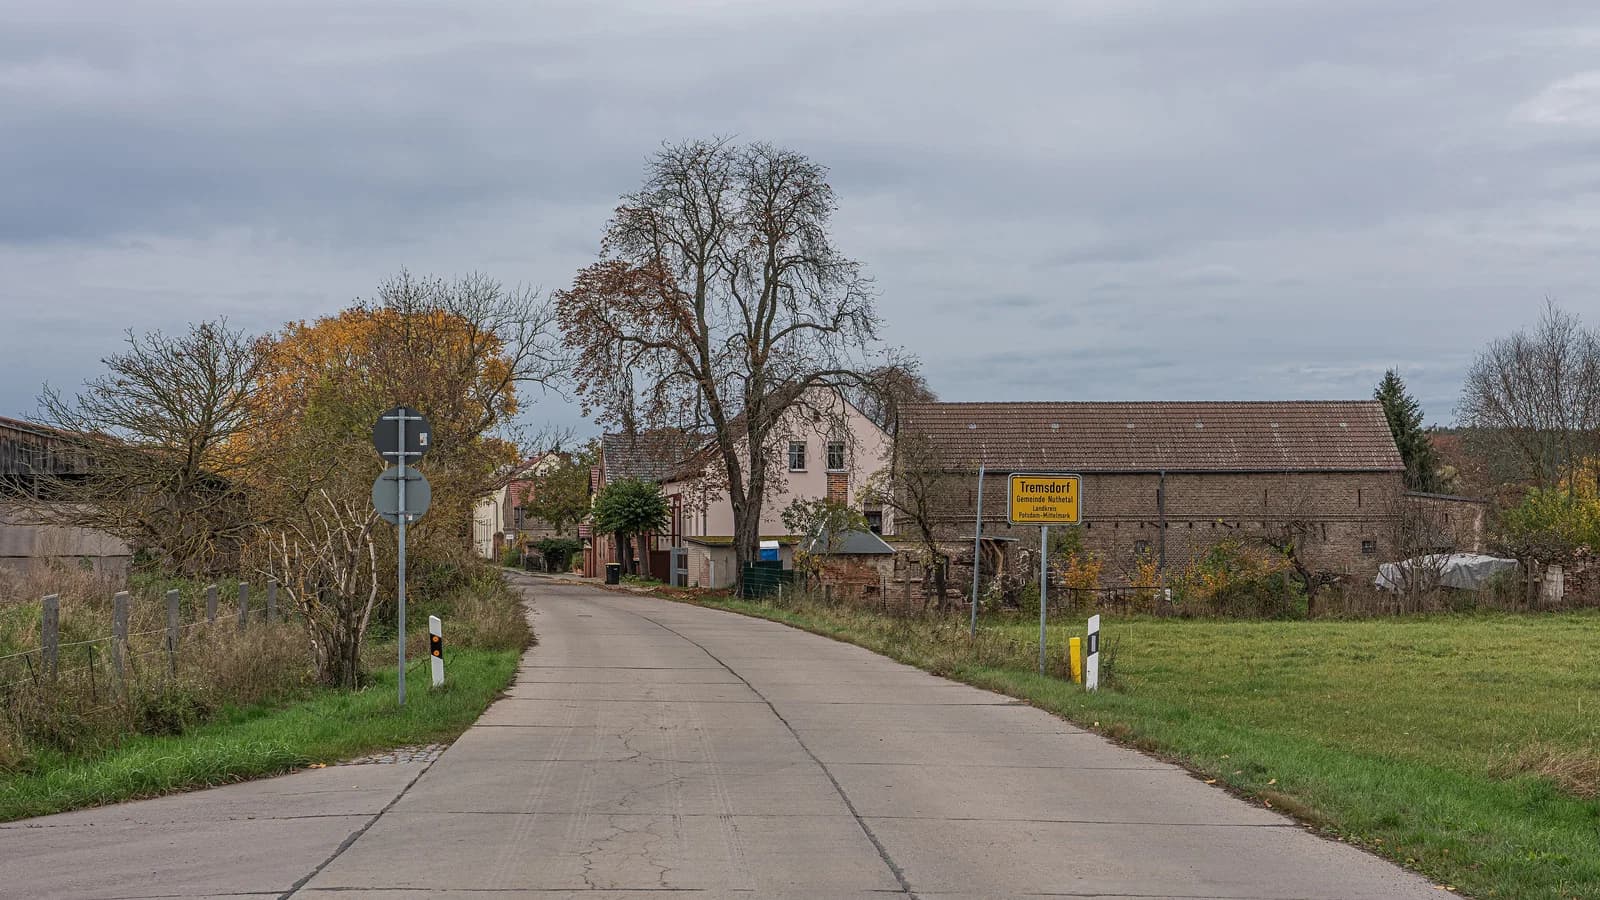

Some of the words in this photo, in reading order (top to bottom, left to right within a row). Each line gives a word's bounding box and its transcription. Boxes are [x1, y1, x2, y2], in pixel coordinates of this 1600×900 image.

[1020, 481, 1071, 493] Tremsdorf
[1016, 495, 1045, 503] Gemeinde
[1048, 495, 1073, 503] Nuthetal
